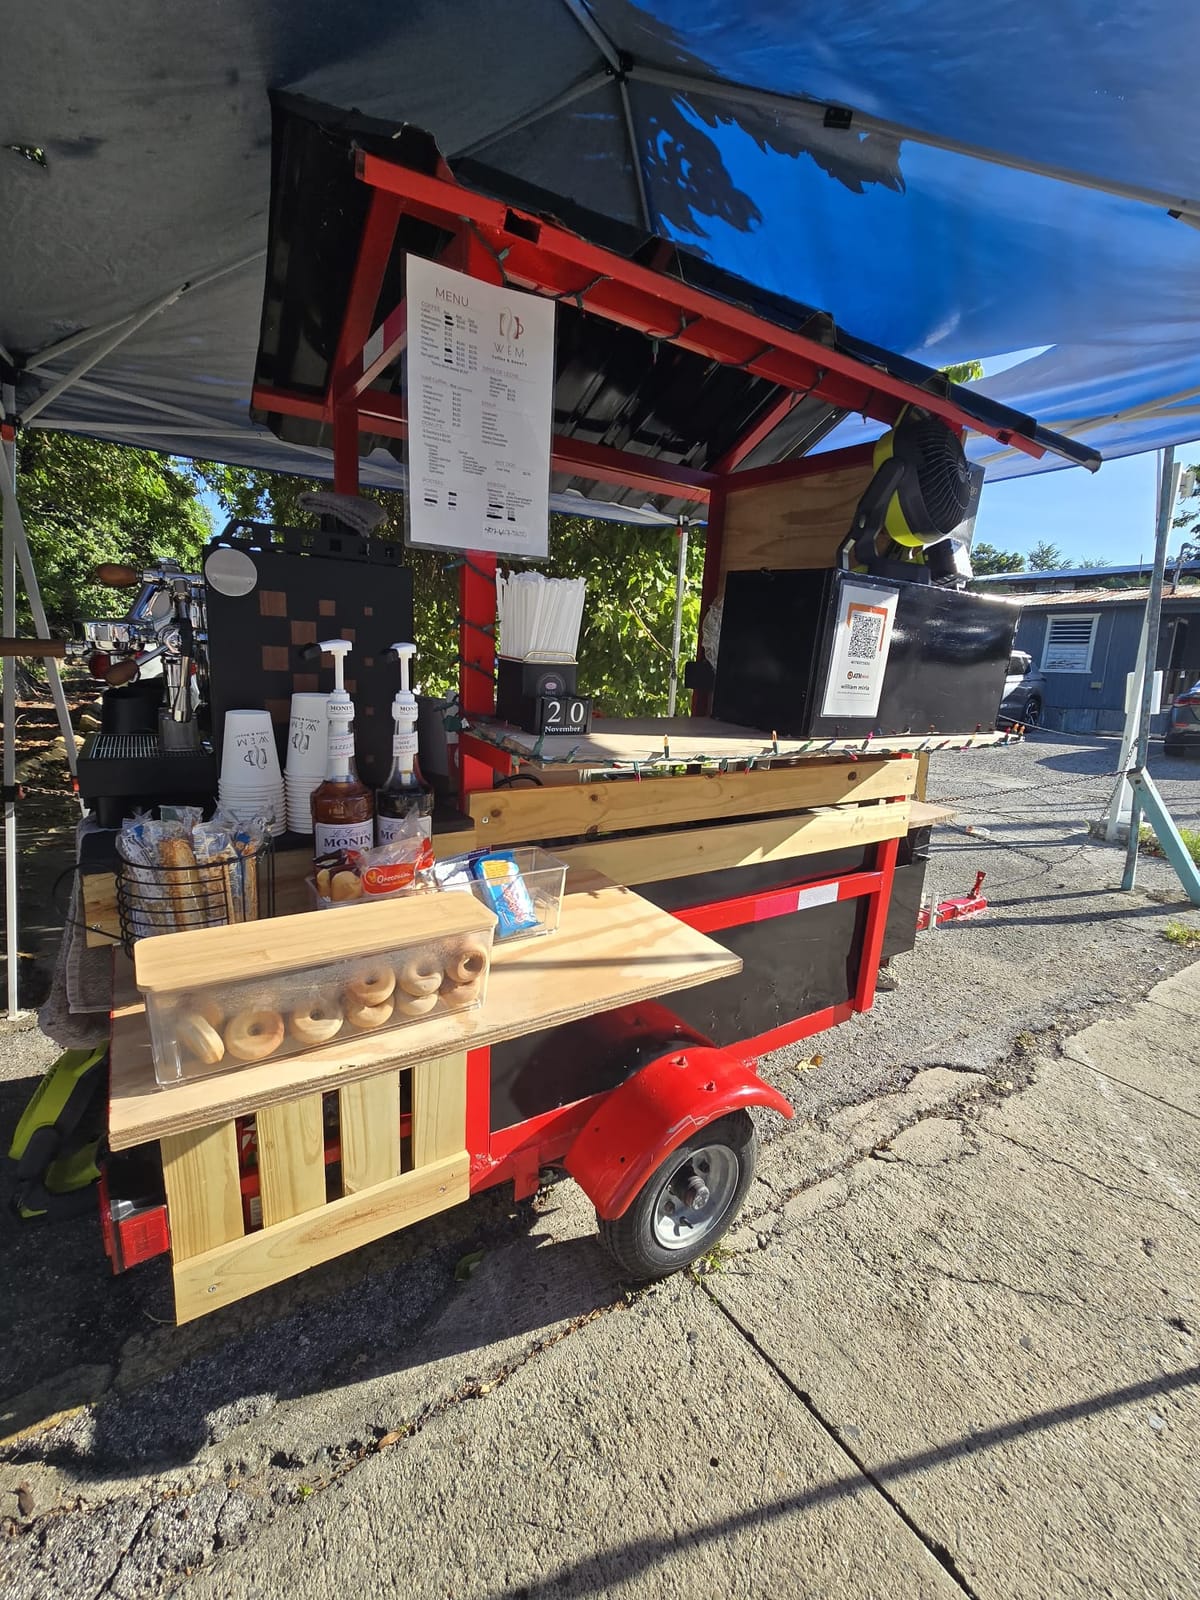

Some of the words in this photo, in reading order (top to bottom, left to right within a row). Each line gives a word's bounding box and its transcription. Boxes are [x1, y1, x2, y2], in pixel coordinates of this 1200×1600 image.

[435, 287, 469, 307] MENU
[544, 725, 581, 733] November
[237, 735, 269, 747] WEM
[323, 834, 371, 848] MONIN
